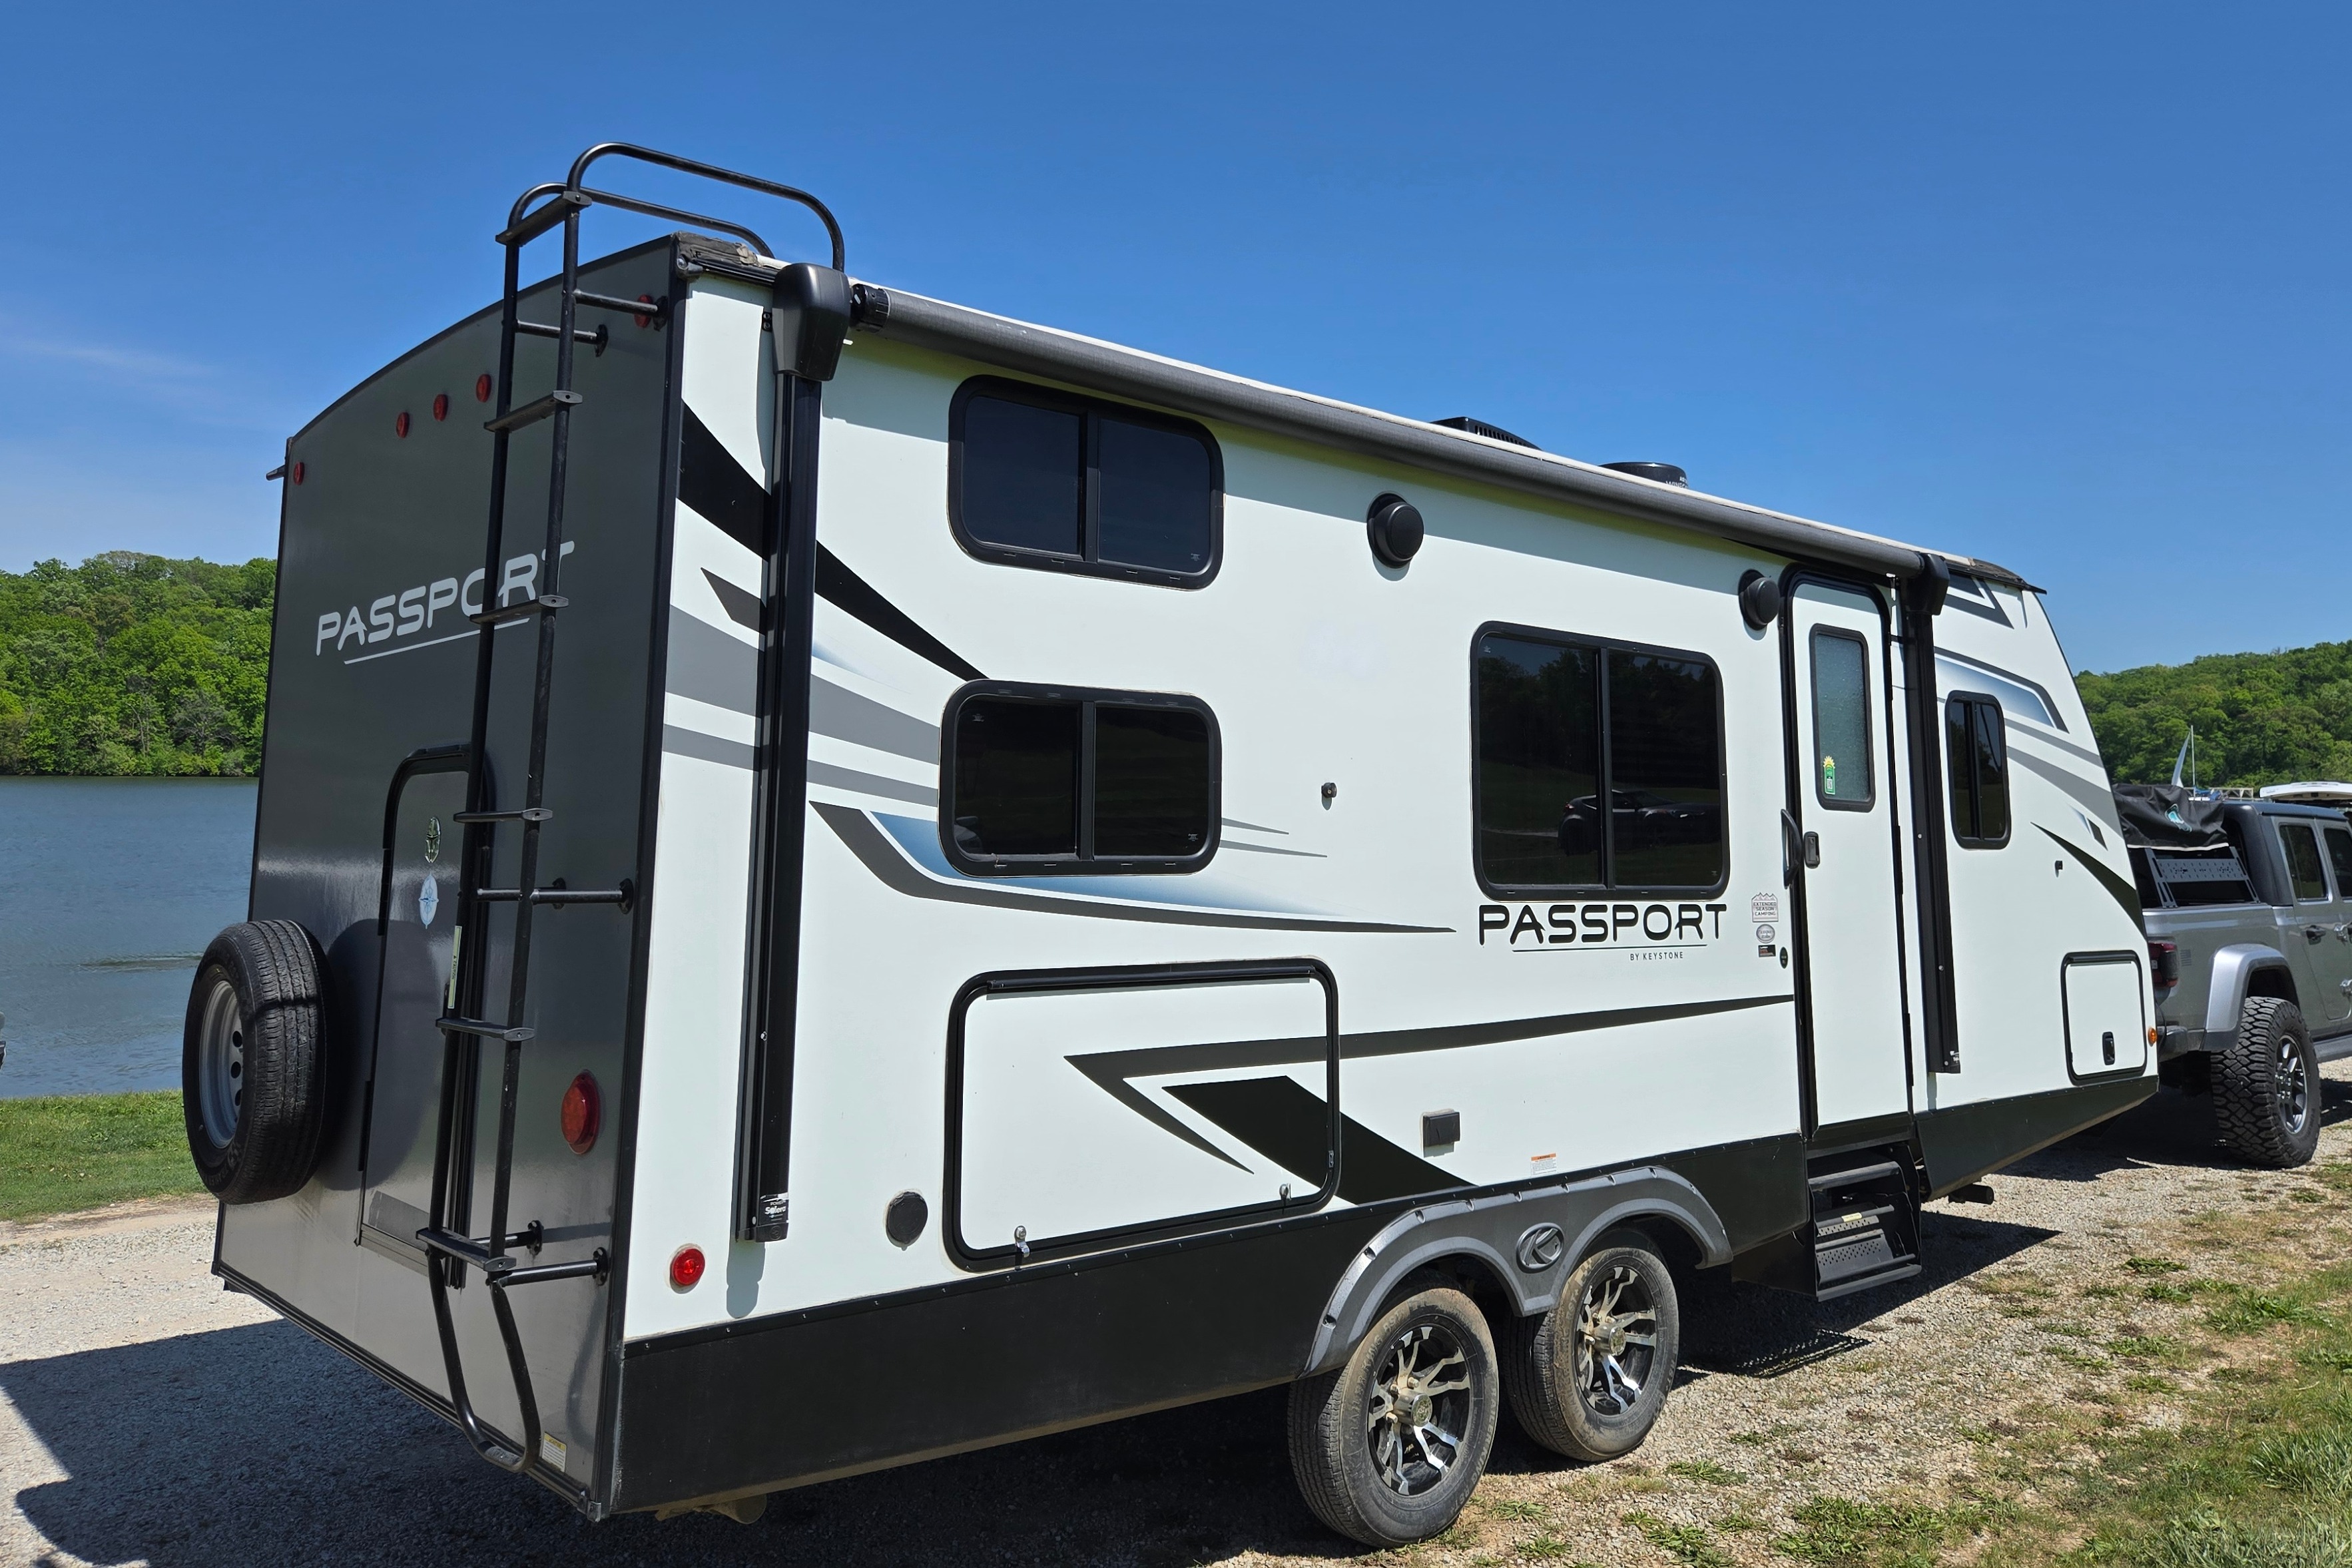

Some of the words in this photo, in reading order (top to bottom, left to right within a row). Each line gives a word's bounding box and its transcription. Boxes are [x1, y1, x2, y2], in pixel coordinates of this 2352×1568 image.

[1479, 904, 1727, 945] PASSPORT
[1643, 951, 1683, 960] KEYSTONE
[764, 1205, 786, 1214] Solera
[1471, 1446, 1488, 1484] KING
